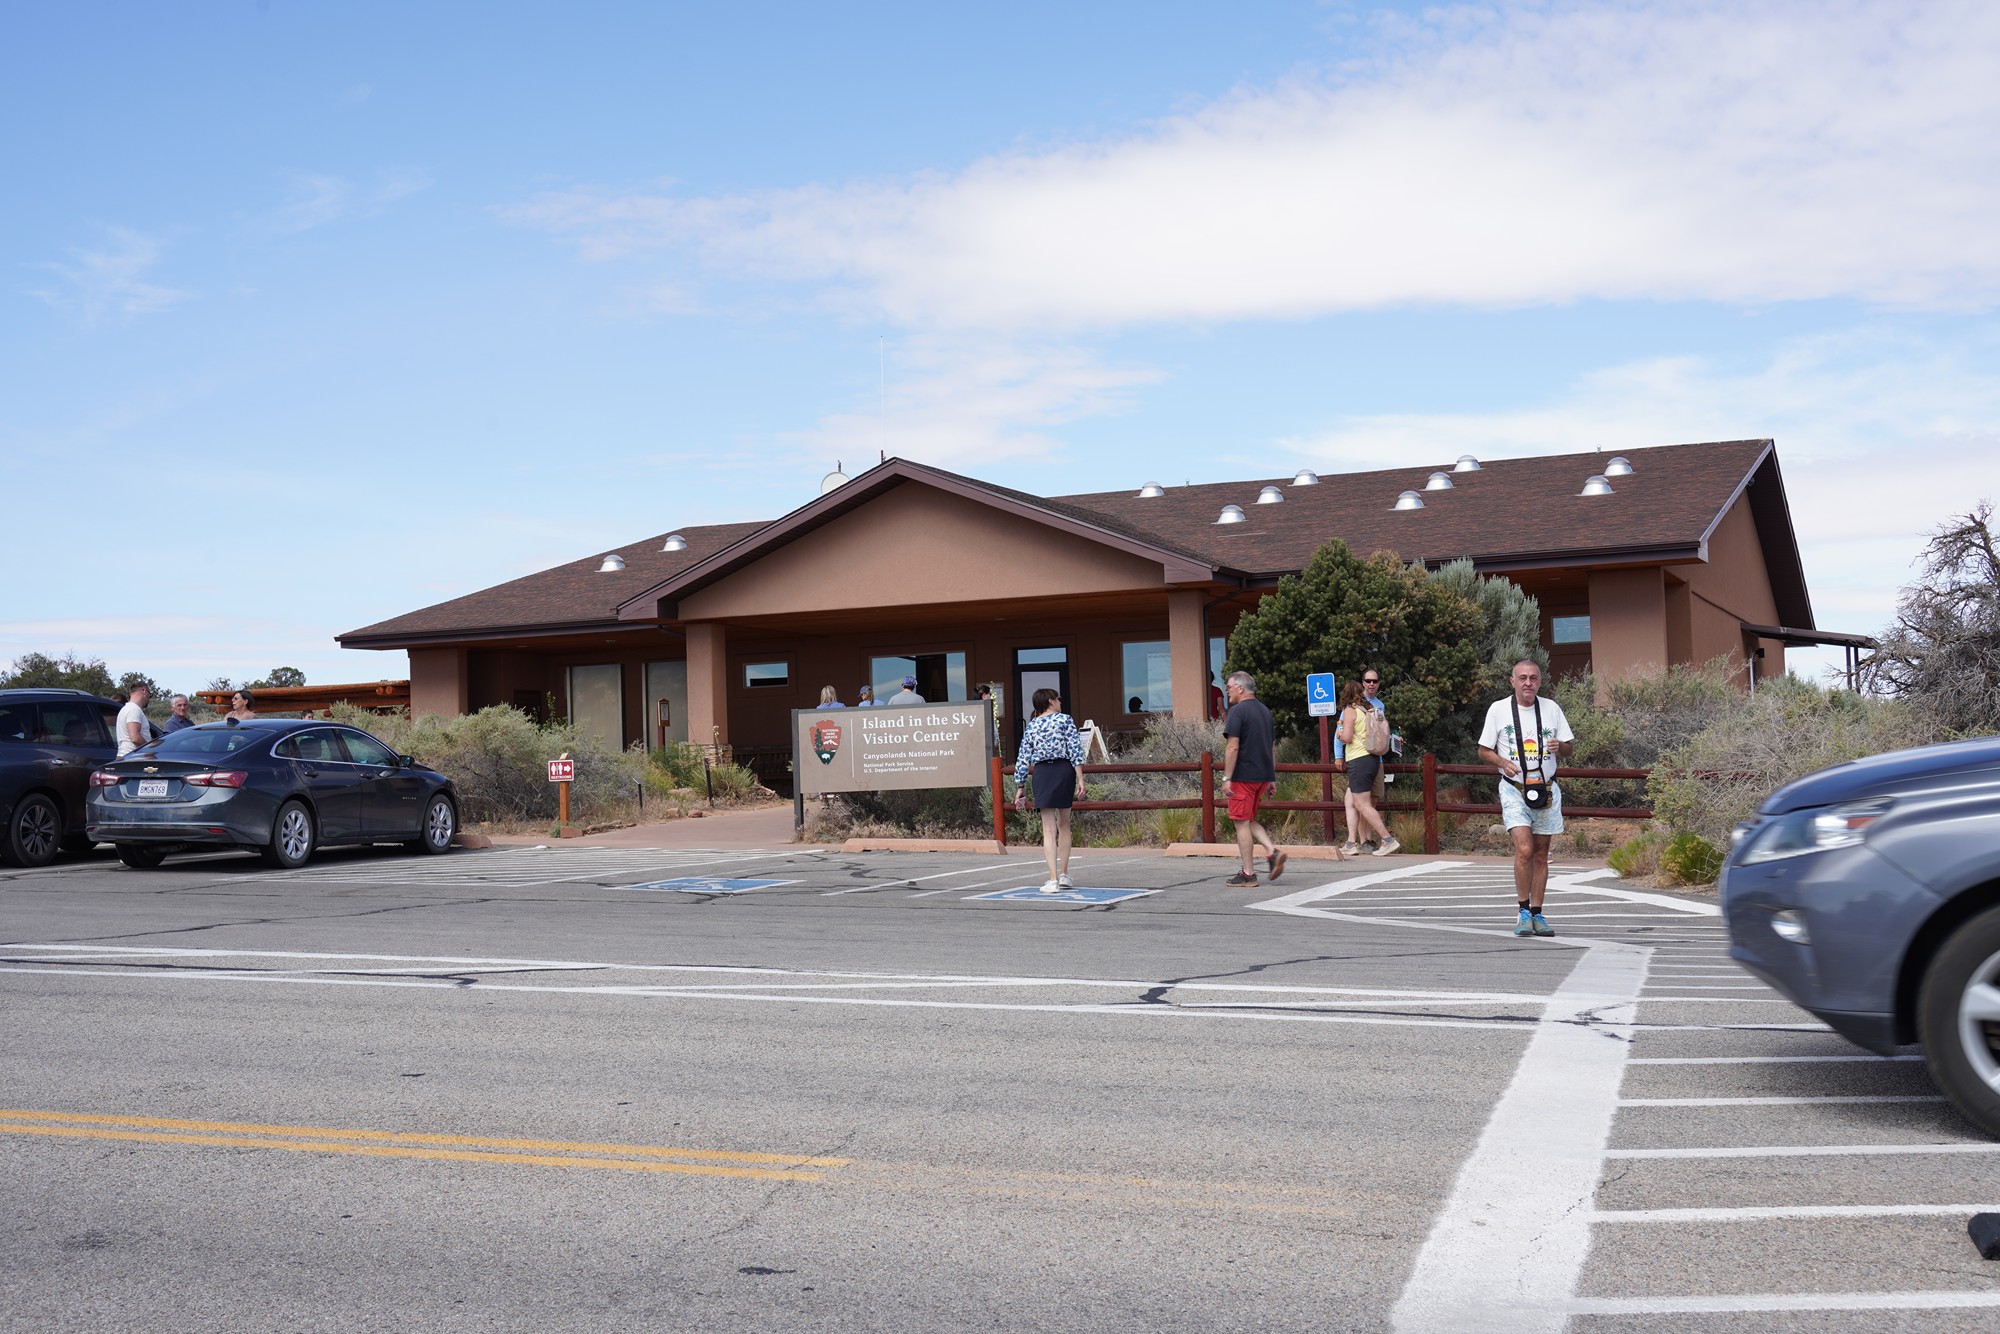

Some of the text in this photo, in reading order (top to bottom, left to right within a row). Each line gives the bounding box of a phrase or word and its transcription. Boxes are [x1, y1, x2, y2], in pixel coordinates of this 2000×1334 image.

[863, 713, 977, 729] Island in the Sky
[864, 731, 960, 744] Visitor Center
[140, 786, 166, 794] 8MGN768
